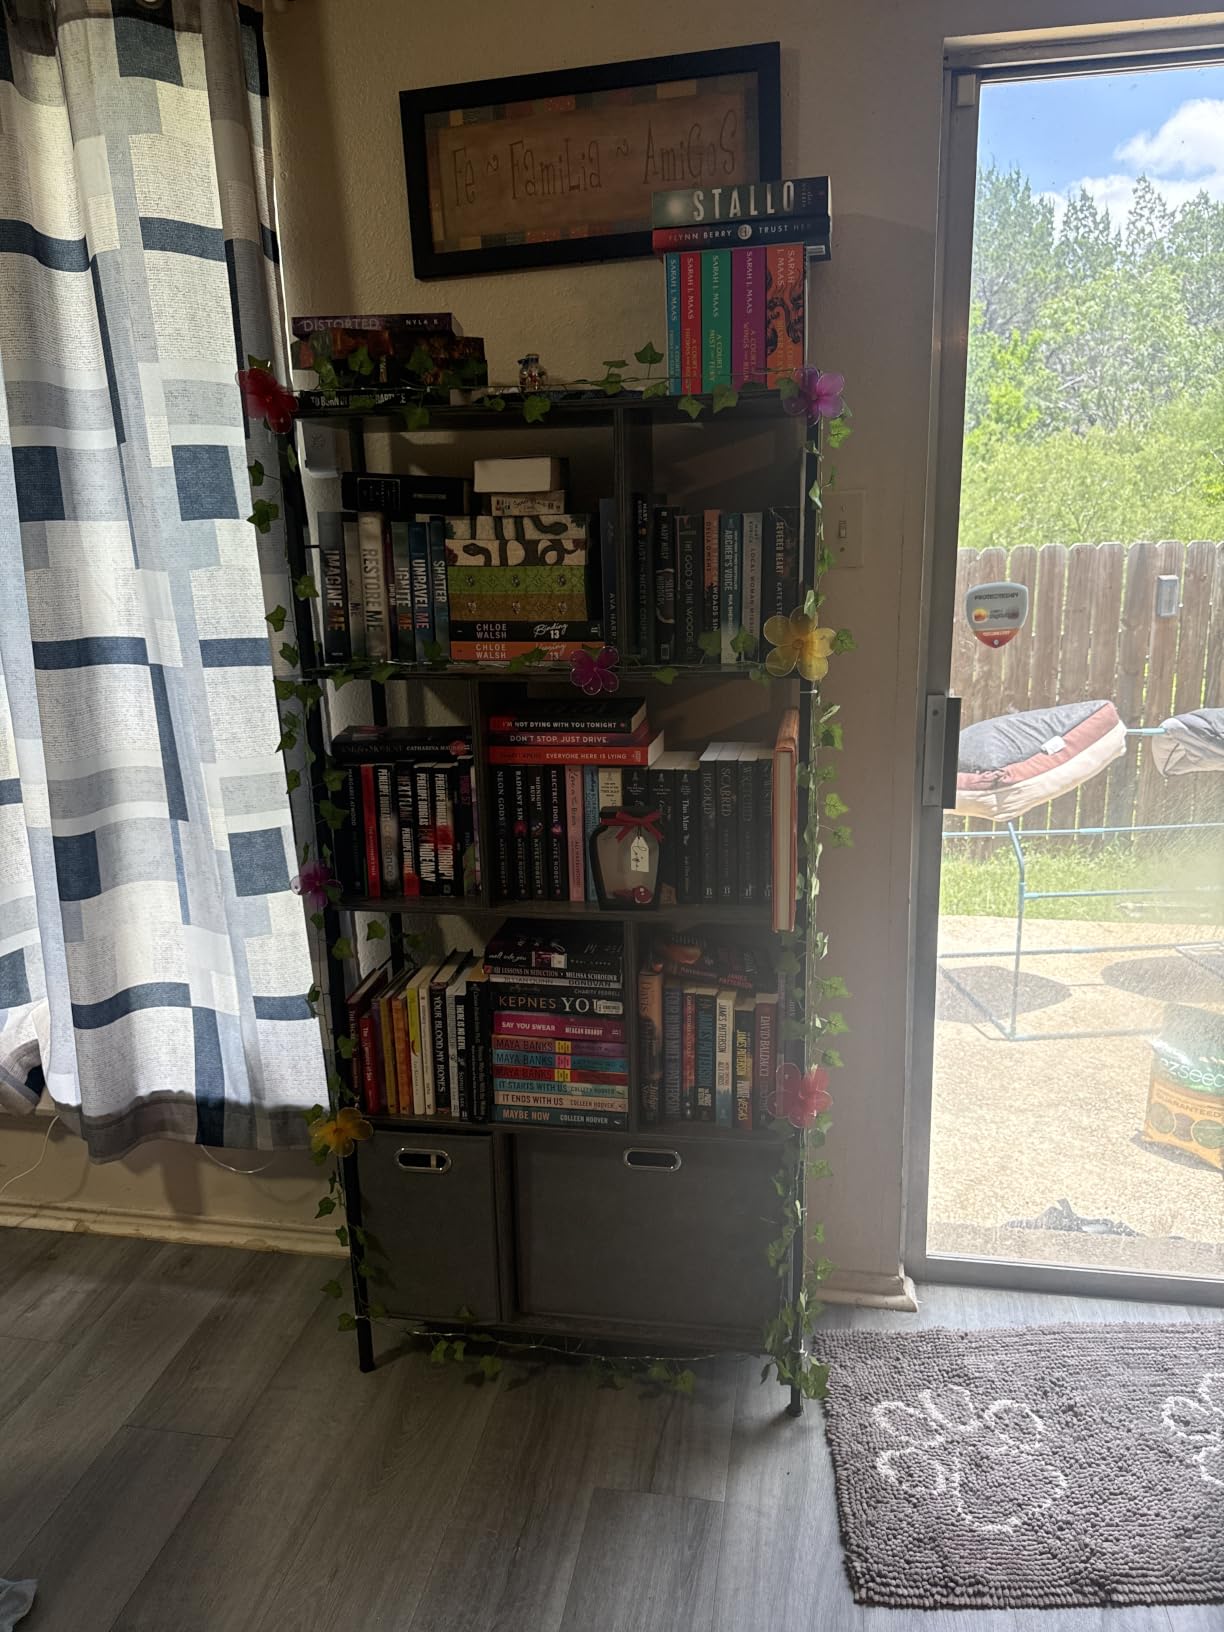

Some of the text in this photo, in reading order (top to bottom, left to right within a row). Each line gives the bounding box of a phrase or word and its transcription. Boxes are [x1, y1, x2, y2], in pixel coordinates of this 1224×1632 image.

[693, 181, 795, 221] STALLO
[668, 229, 732, 242] FLYNN BERRY
[758, 224, 788, 234] TRUST
[777, 257, 785, 286] MAAS
[787, 250, 795, 284] SARAH
[303, 319, 380, 332] DISTORTED
[405, 319, 429, 327] NYLA
[775, 521, 784, 574] SEVERED HEART
[684, 554, 693, 577] GOD
[724, 529, 734, 592] ARCHER'S VOICE
[324, 549, 345, 631] IMAGINE ME
[362, 548, 383, 632] RESTORE ME
[432, 560, 447, 603] SHATTER
[396, 567, 412, 630] IGNITE ME
[412, 558, 430, 630] UNRAVEL ME
[608, 592, 617, 610] AVA
[475, 624, 508, 632] CHLOE
[475, 631, 508, 639] WALSH
[549, 629, 559, 640] 13
[685, 607, 694, 643] WOODS
[475, 643, 507, 651] CHLOE
[475, 651, 507, 659] WALSH
[549, 651, 559, 661] 13
[586, 721, 616, 729] TONIGHT
[510, 735, 535, 743] DON'T
[560, 735, 580, 743] JUST
[377, 768, 390, 796] PENELOPE
[720, 767, 731, 817] SCARRED
[416, 773, 429, 826] PENELOPE DOUGLAS
[434, 773, 448, 826] PENELOPE DOUGLAS
[496, 770, 506, 821] NEON GODS
[515, 770, 524, 821] RADIANT SIN
[703, 772, 712, 815] HOOKED
[551, 805, 559, 824] IDOL
[682, 815, 690, 831] Man
[401, 827, 412, 852] PENELOPE
[438, 844, 454, 881] CORRUPT
[501, 968, 524, 976] LESSONS
[456, 1004, 465, 1021] THERE
[499, 996, 557, 1009] KEPNES
[501, 1021, 515, 1029] SAY
[516, 1022, 530, 1030] YOU
[531, 1023, 556, 1032] SWEAR
[718, 1003, 727, 1053] JAMES PATTERSON
[760, 1015, 771, 1040] DAVID
[434, 996, 446, 1092] YOUR BLOOD MY BONES
[496, 1039, 553, 1051] MAYA BANKS
[698, 1011, 713, 1087] JAMES PATTERSON
[736, 1030, 748, 1076] JAMES PATTERSON
[496, 1053, 553, 1066] MAYA BANKS
[759, 1040, 771, 1077] BALDACCI
[499, 1081, 568, 1093] IT STARTS WITH US
[502, 1092, 564, 1106] IT ENDS WITH US
[570, 1099, 615, 1109] COLLEEN HOOVER
[737, 1098, 748, 1120] VEGAS
[502, 1109, 550, 1122] MAYBE NOW
[559, 1113, 608, 1125] COLLEEN HOOVER
